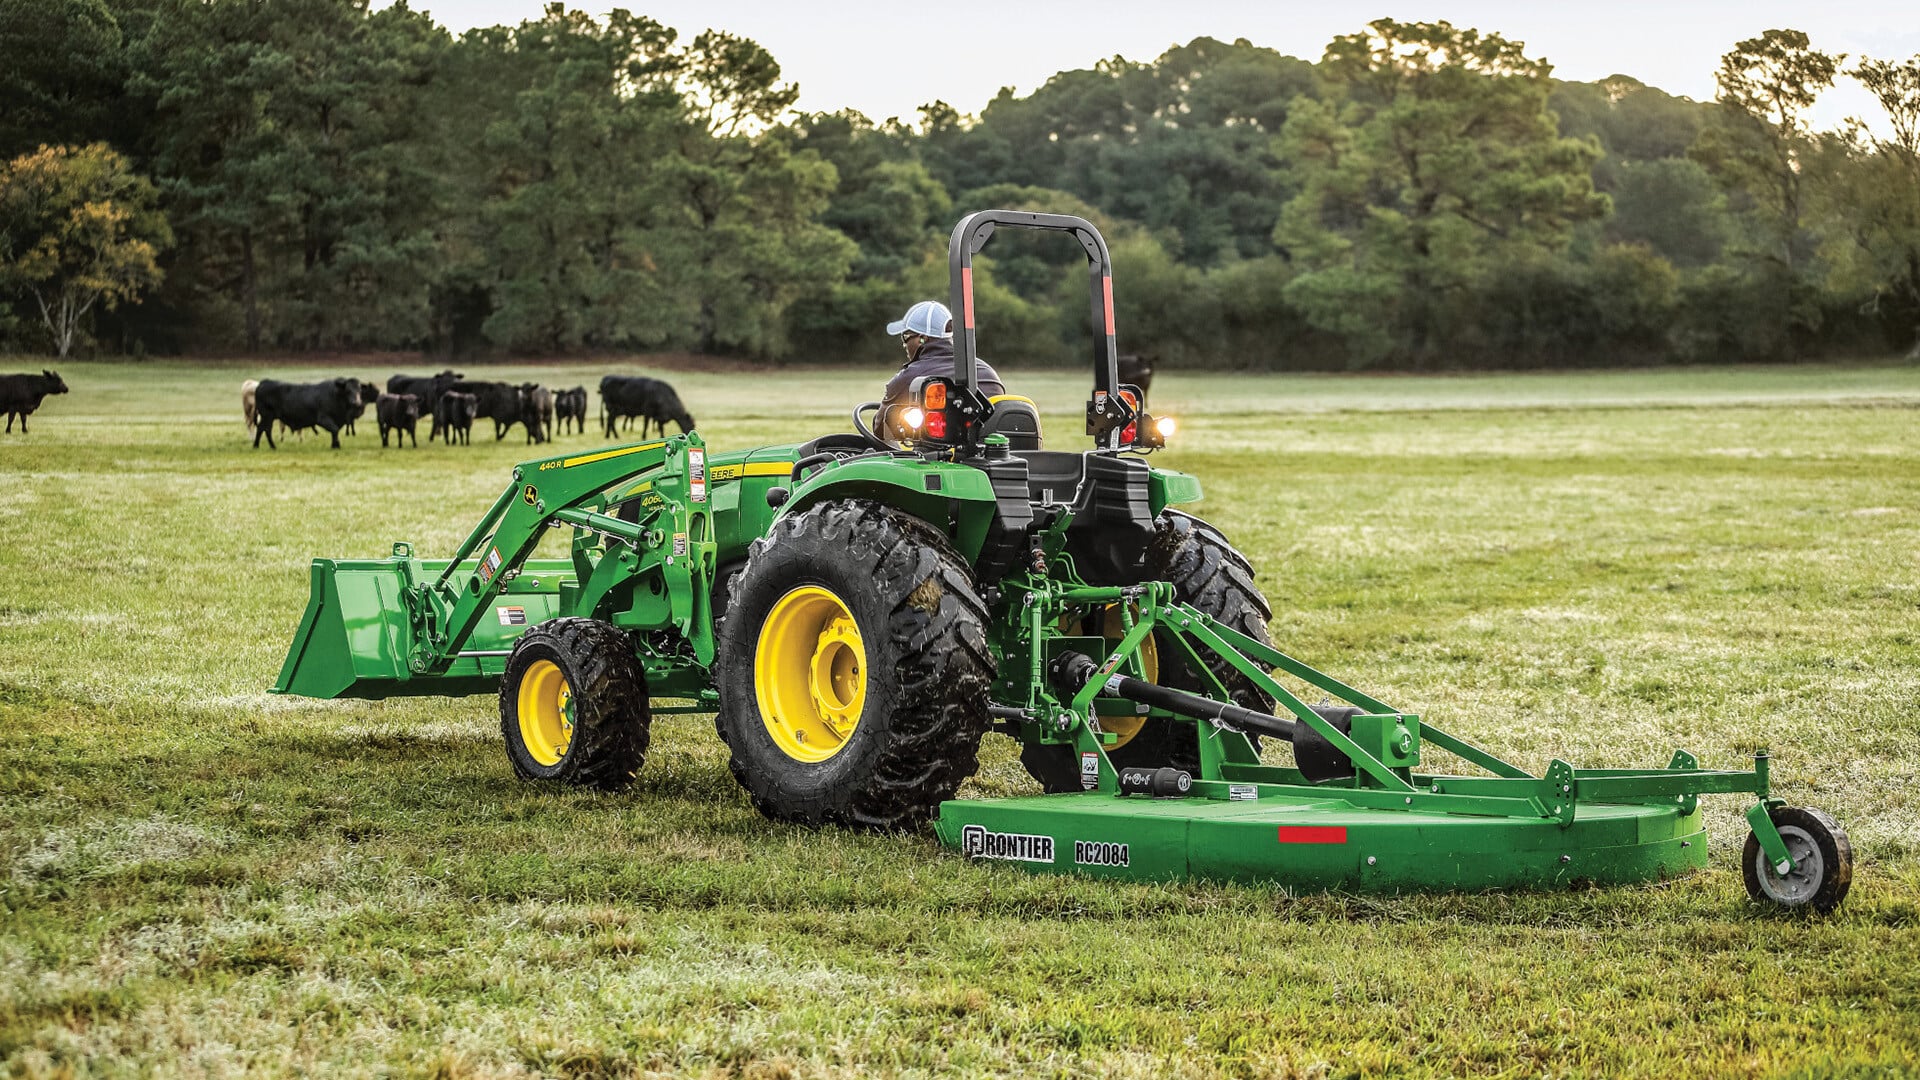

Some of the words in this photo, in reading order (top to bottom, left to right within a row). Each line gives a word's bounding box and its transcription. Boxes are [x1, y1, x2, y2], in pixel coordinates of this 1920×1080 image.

[711, 469, 735, 479] EERE
[963, 826, 1054, 862] FRONTIER
[1075, 841, 1129, 866] RC2084
